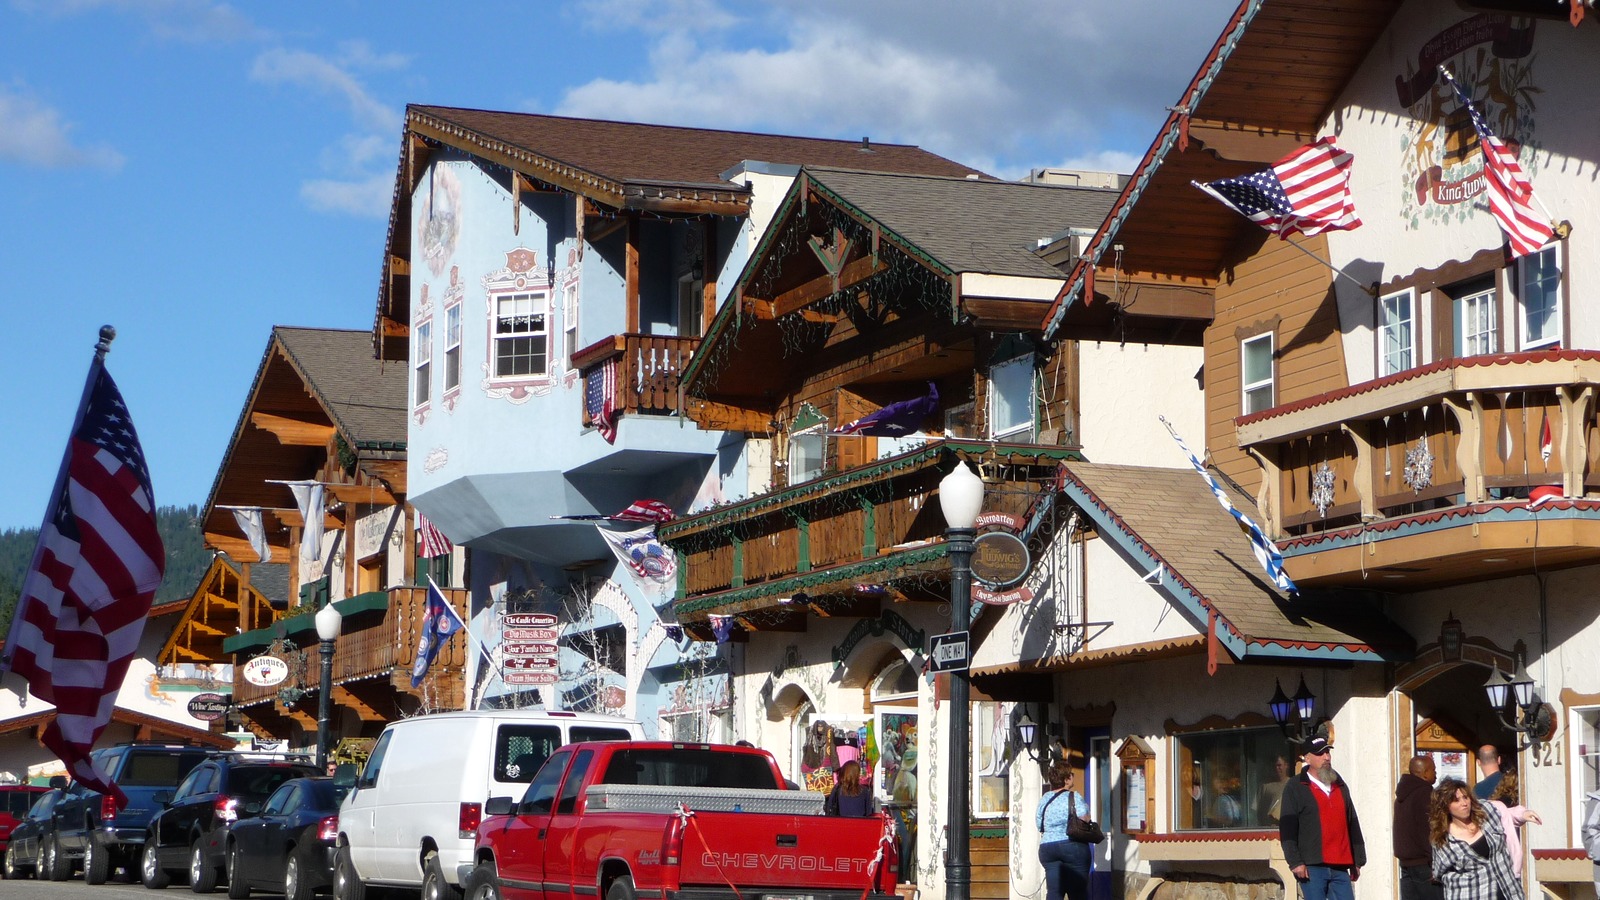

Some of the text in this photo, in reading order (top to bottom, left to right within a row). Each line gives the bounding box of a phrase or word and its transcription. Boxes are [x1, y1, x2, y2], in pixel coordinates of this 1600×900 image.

[976, 513, 1015, 526] Biergarten
[516, 616, 531, 624] Candle
[531, 616, 554, 624] Connection
[539, 630, 553, 639] Box
[891, 614, 914, 645] Store
[539, 645, 555, 653] Name
[941, 643, 964, 660] ONE WAY
[247, 657, 285, 673] Antiques
[189, 702, 227, 712] Wine Tasting
[701, 852, 868, 873] CHEVROLET
